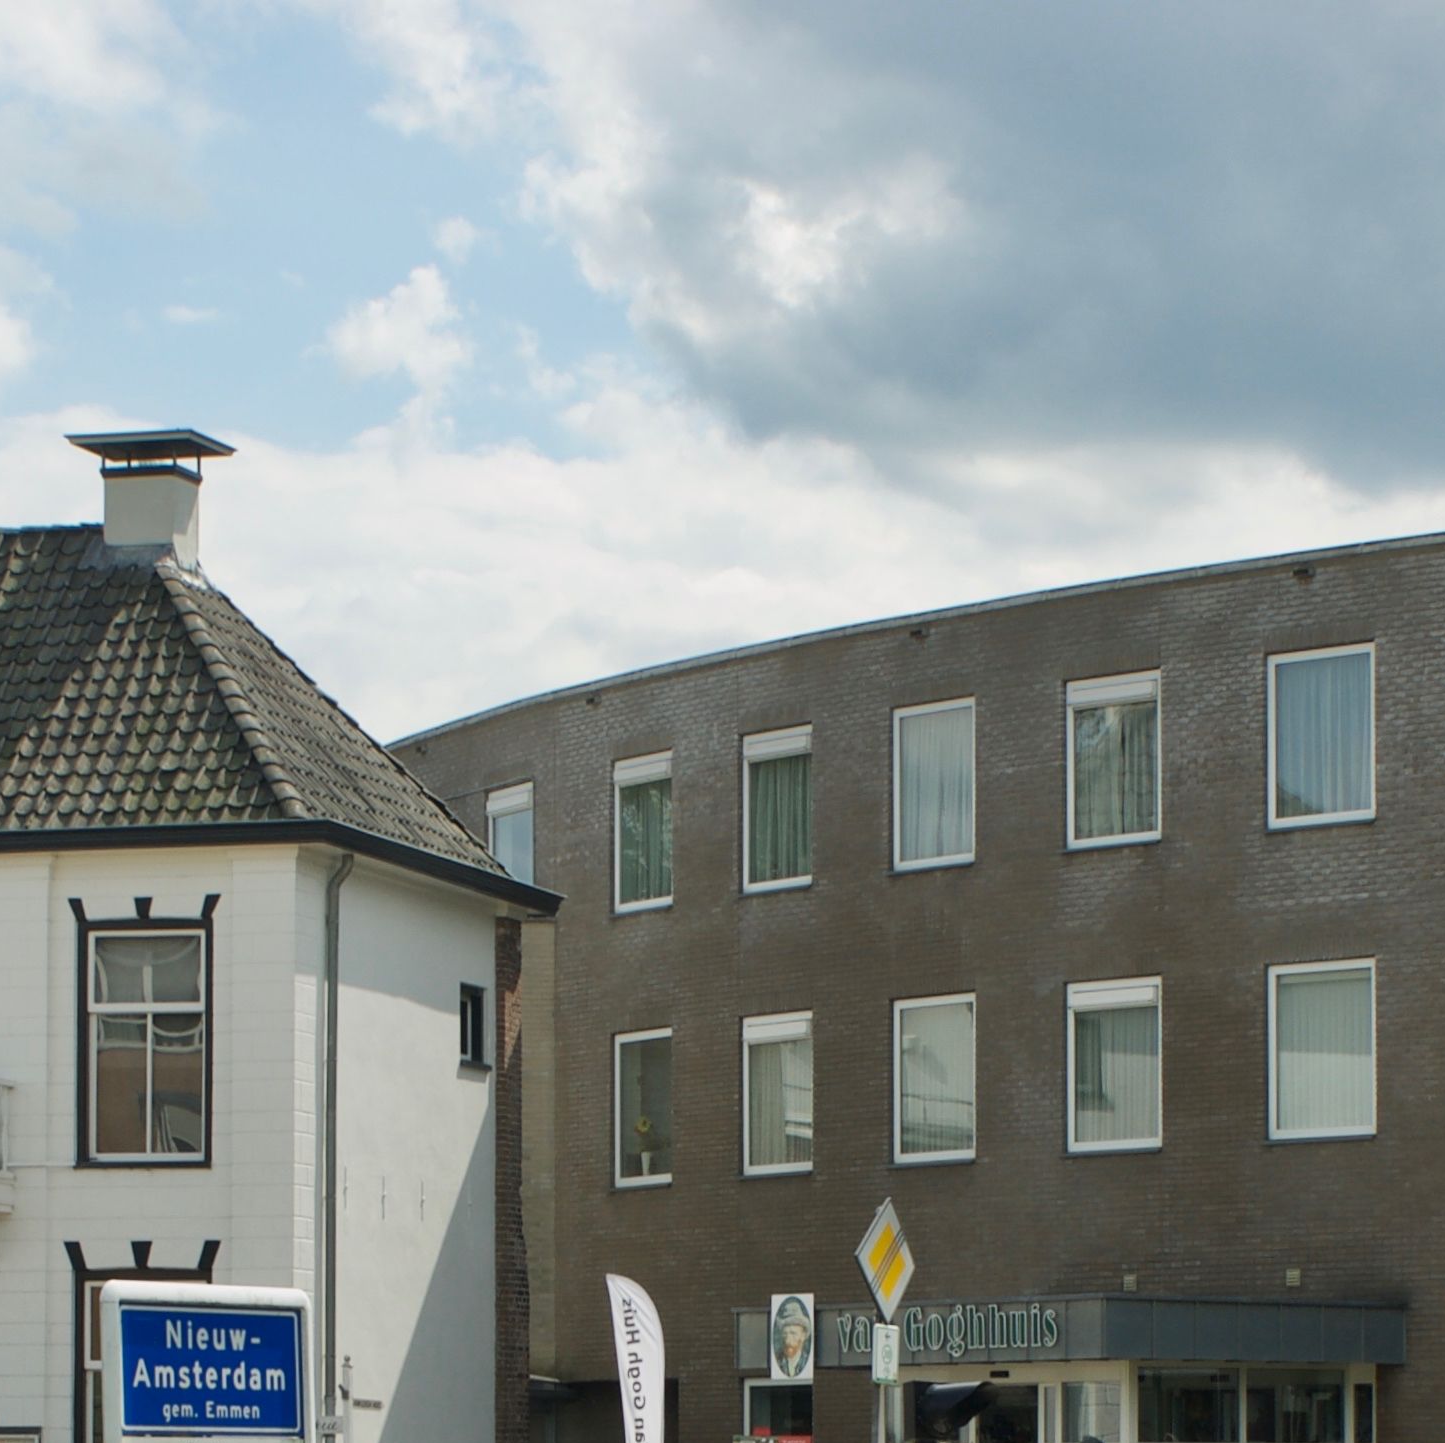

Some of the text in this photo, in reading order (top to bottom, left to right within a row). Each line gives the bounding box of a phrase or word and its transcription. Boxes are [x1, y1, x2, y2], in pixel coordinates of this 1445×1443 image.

[165, 1318, 262, 1351] Nieuw-
[836, 1312, 873, 1354] va
[902, 1303, 1058, 1358] Goghhuis
[133, 1358, 286, 1391] Amsterdam
[162, 1400, 261, 1423] gem. Emmen
